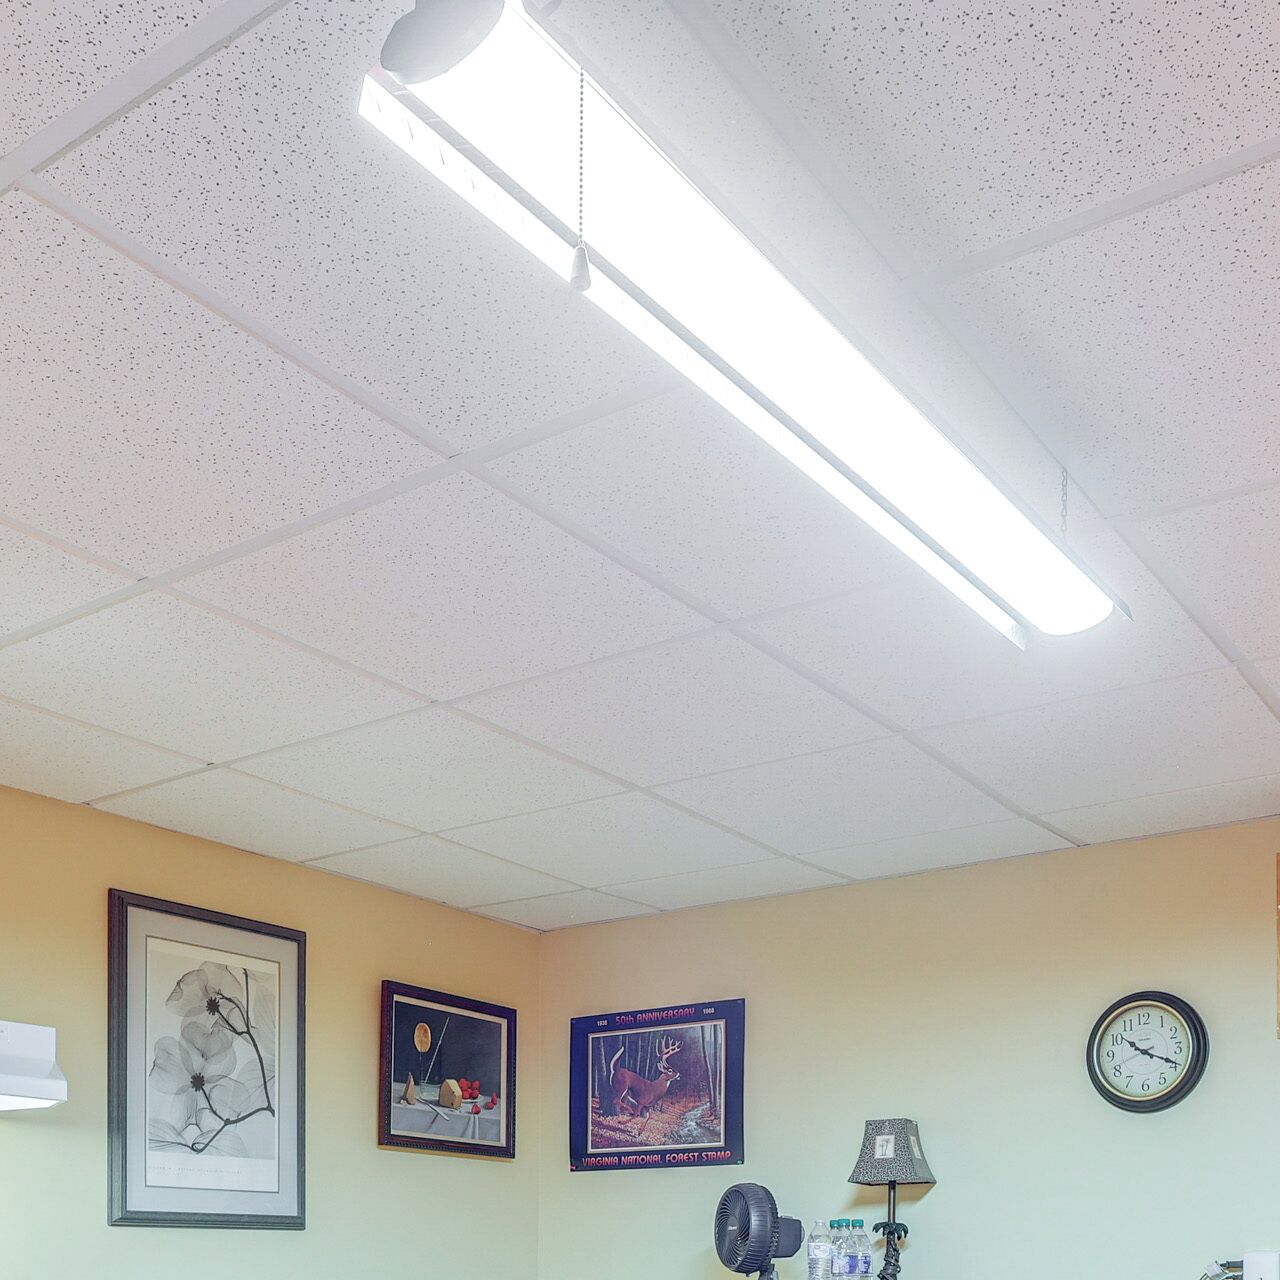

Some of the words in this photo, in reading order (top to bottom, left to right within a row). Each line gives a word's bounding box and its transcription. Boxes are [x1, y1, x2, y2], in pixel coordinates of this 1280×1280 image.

[615, 1016, 635, 1025] 50th
[636, 1008, 695, 1023] ANNIVERSARY
[1137, 1012, 1150, 1026] 12
[1159, 1015, 1164, 1028] 1
[1123, 1018, 1133, 1032] 11
[1111, 1033, 1123, 1046] 10
[1170, 1026, 1178, 1040] 2
[1174, 1041, 1182, 1055] 3
[1107, 1050, 1115, 1062] 9
[1113, 1065, 1122, 1077] 8
[1169, 1058, 1178, 1072] 4
[1125, 1075, 1133, 1088] 7
[1141, 1078, 1150, 1092] 6
[1158, 1073, 1167, 1085] 5
[582, 1156, 619, 1167] VIRGINIA
[621, 1154, 662, 1164] NATIONAL
[665, 1152, 698, 1163] FOREST
[701, 1151, 731, 1160] STAMP
